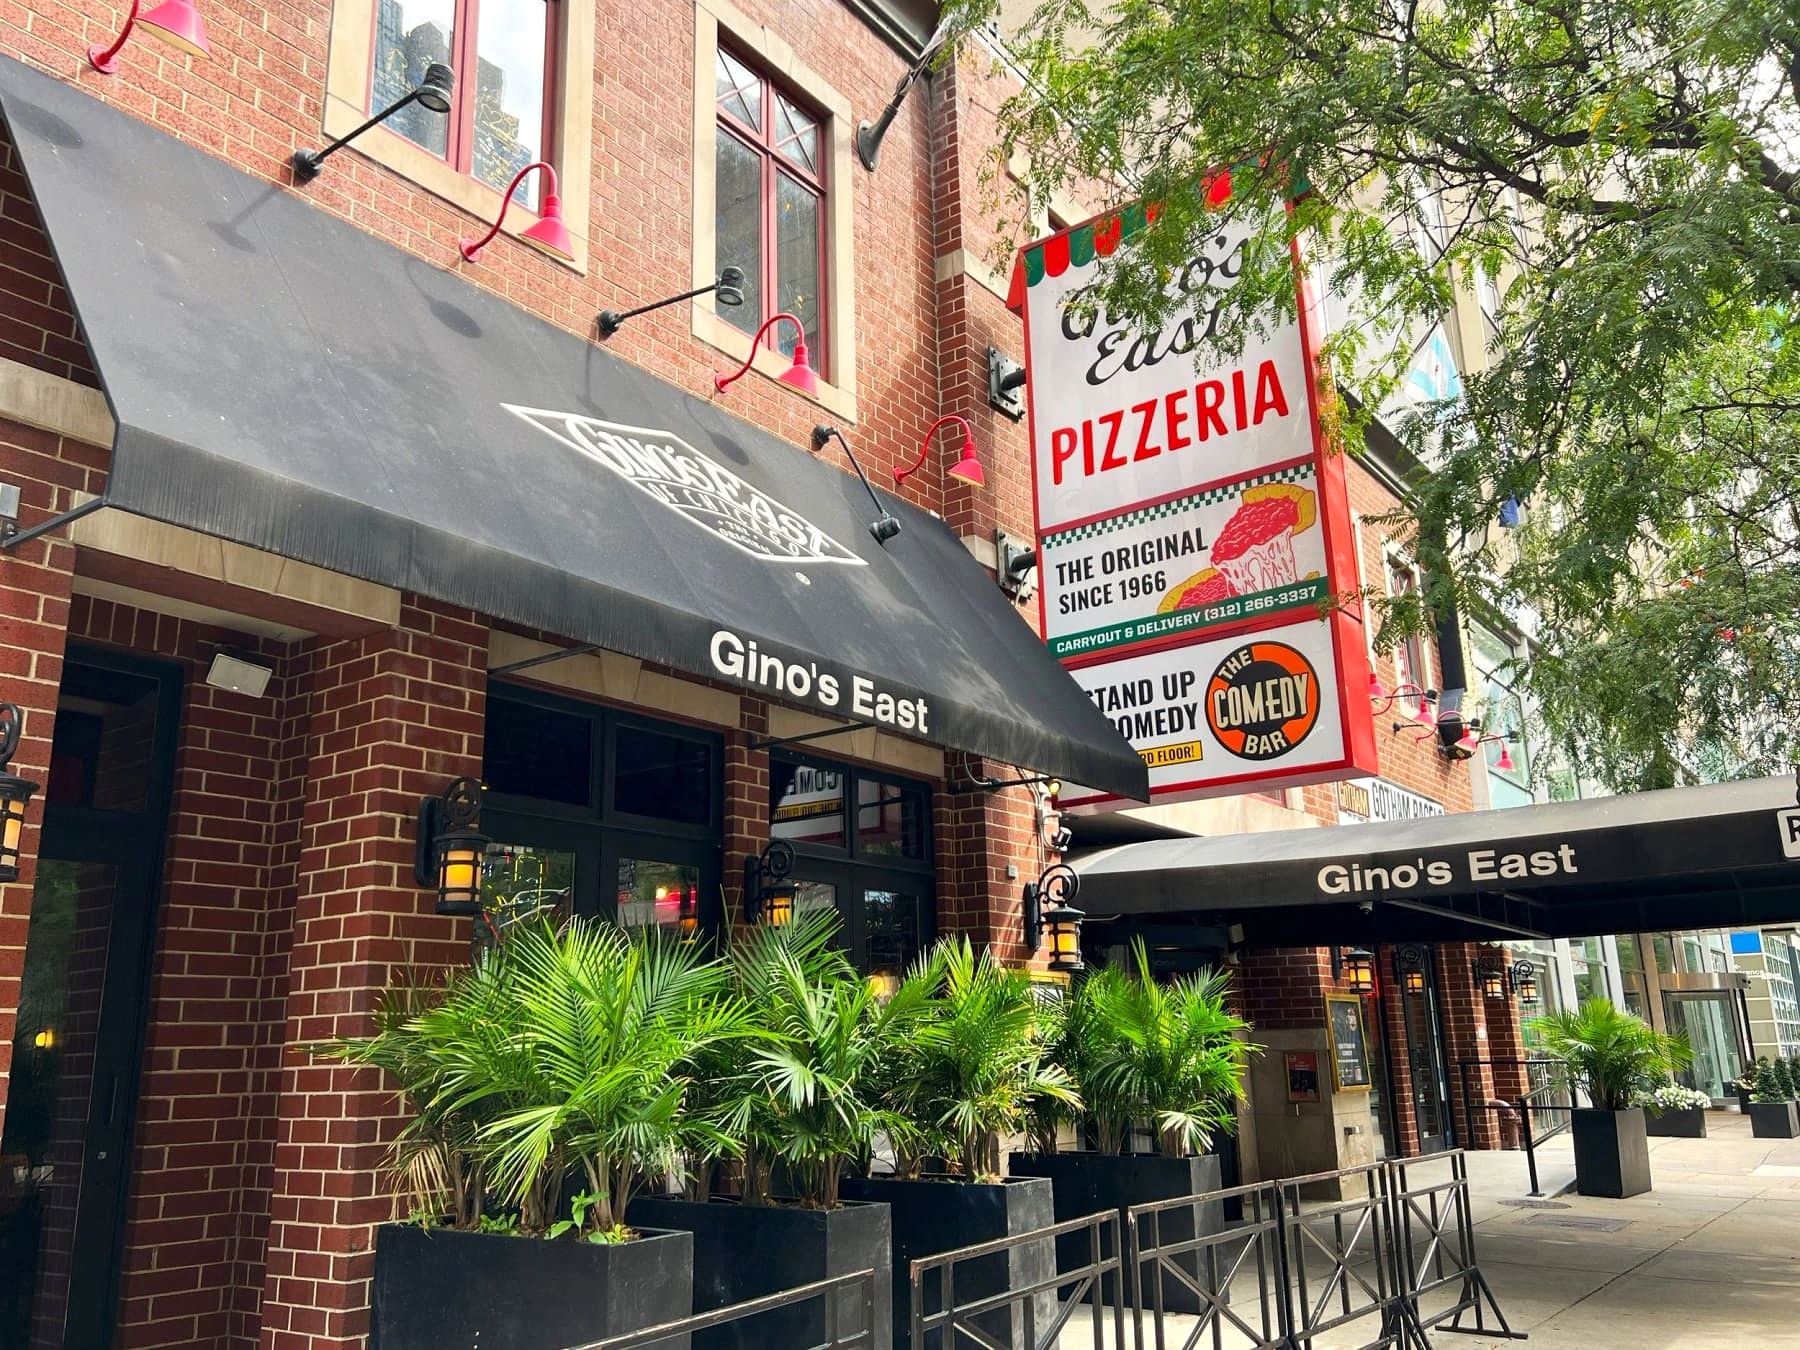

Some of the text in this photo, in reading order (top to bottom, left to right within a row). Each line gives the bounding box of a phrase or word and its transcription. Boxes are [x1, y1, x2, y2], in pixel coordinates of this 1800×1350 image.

[1051, 360, 1289, 485] PIZZERIA
[1055, 527, 1209, 586] THE ORIGINAL
[1060, 570, 1166, 615] SINCE 1966
[1056, 629, 1122, 653] CARRYOUT
[1137, 611, 1202, 636] DELIVERY
[1204, 602, 1241, 622] (312)
[1245, 585, 1318, 613] 266-3337
[709, 630, 929, 735] Gino's East
[1161, 670, 1196, 701] UP
[1218, 649, 1252, 680] THE
[1107, 702, 1199, 741] OMEDY
[1213, 673, 1309, 729] COMEDY
[1157, 745, 1195, 763] FLOOR!
[1244, 730, 1288, 755] BAR
[1372, 781, 1411, 822] GOTHAM
[1317, 843, 1578, 894] Gino's East
